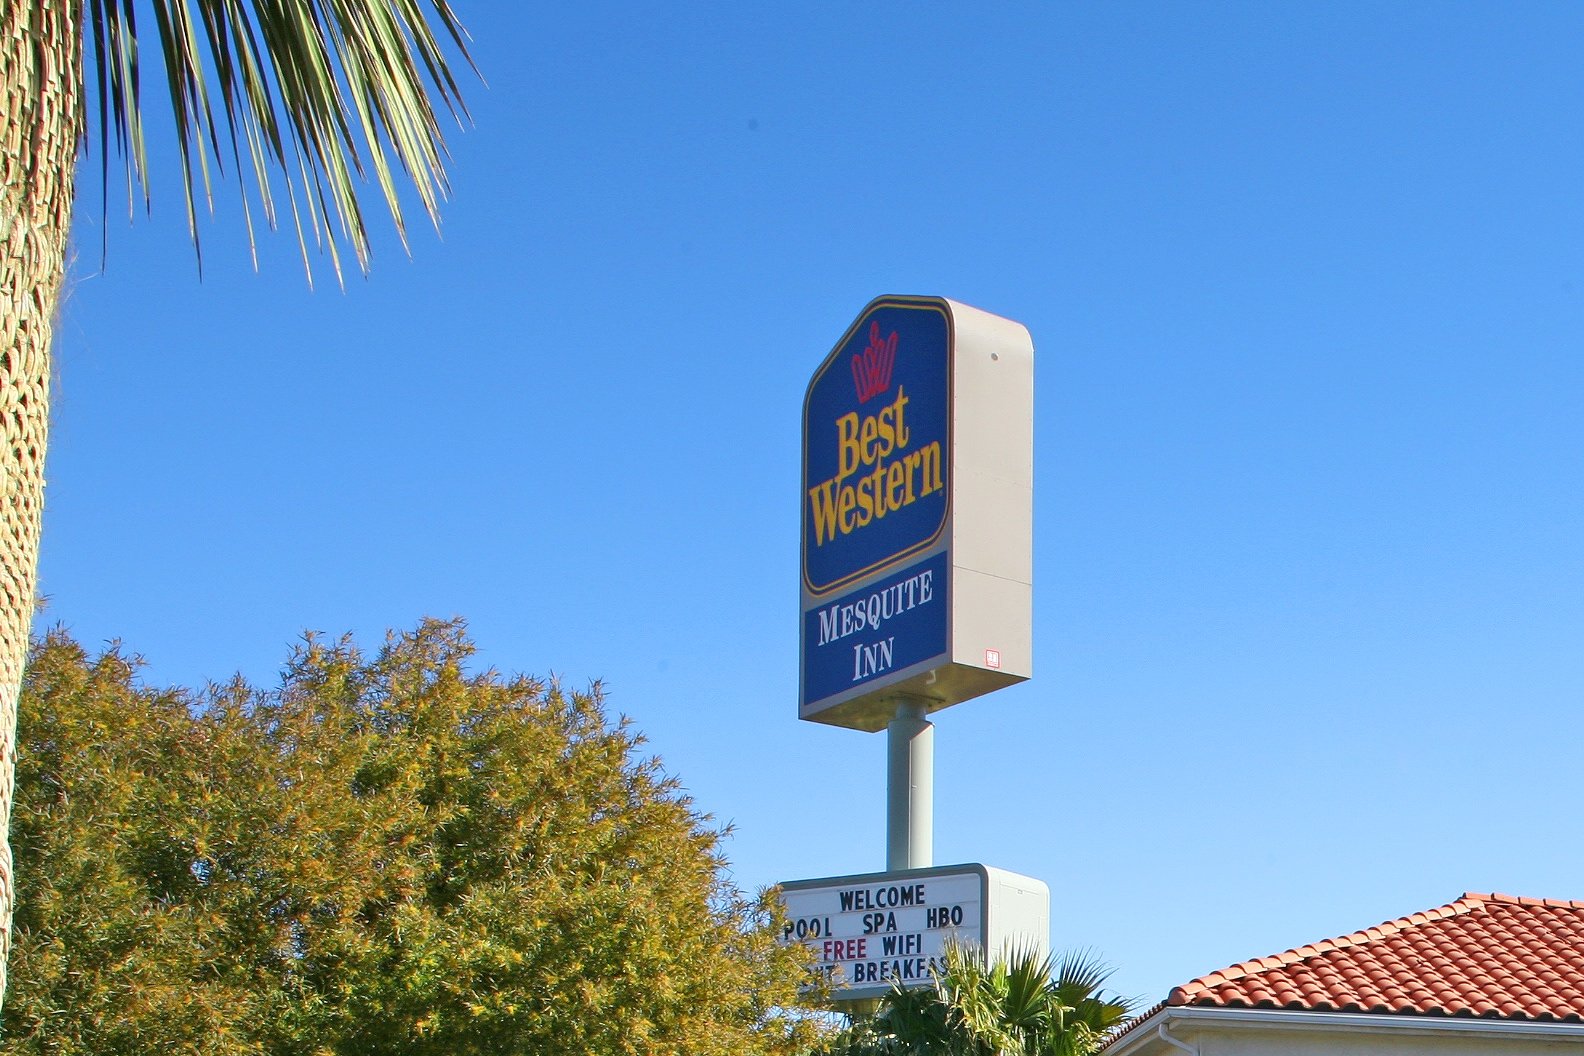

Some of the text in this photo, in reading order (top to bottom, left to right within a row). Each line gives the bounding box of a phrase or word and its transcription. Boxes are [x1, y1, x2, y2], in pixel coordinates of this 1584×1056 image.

[836, 384, 910, 480] Best
[808, 440, 943, 548] Western
[817, 569, 934, 646] MESQUITE
[852, 637, 895, 682] INN
[840, 884, 925, 912] WELCOME
[784, 905, 963, 940] POOL SPA HBO
[823, 933, 922, 961] FREE WIFI
[854, 956, 950, 983] BREAKFAS
